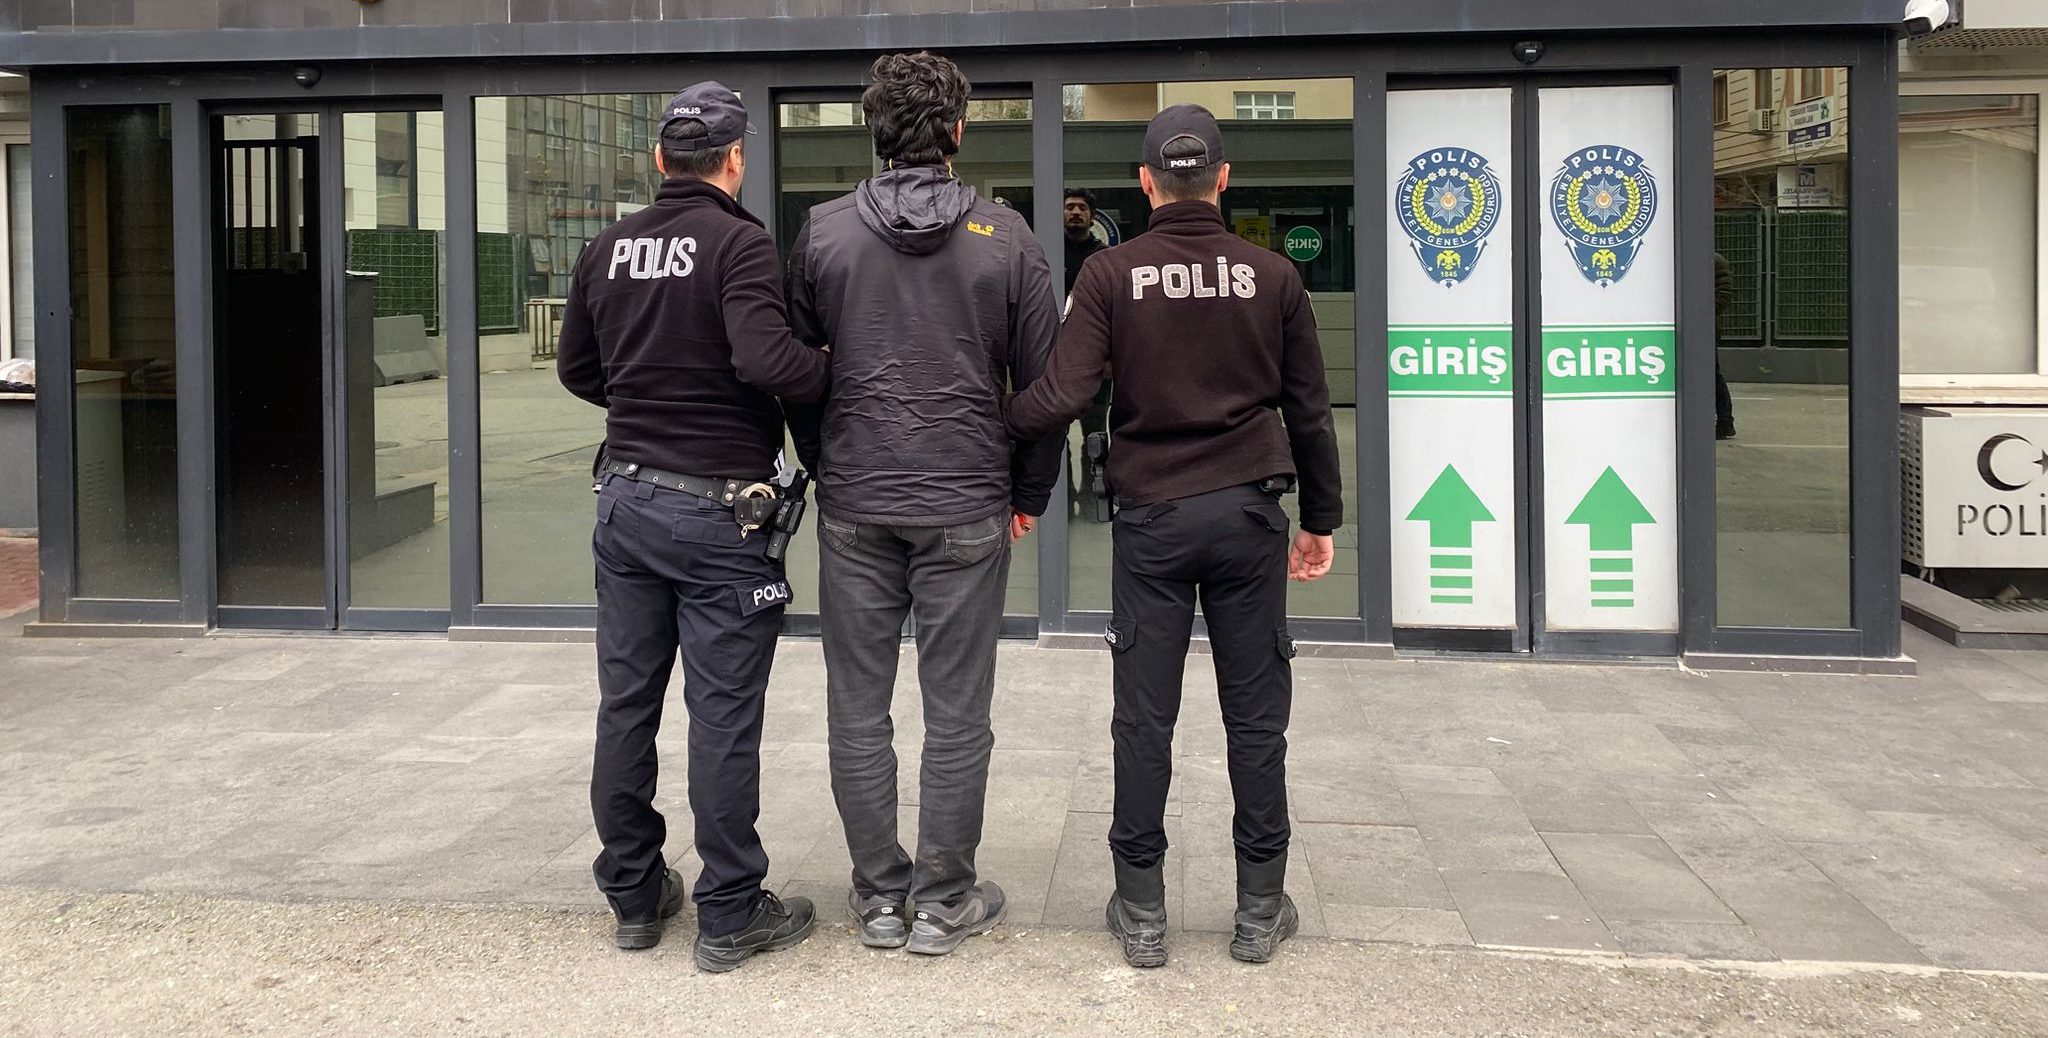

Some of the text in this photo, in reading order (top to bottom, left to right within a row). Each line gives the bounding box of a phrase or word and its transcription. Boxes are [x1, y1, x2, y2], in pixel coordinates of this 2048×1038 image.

[1416, 150, 1480, 171] POLİS
[1571, 149, 1635, 169] POLİS
[1427, 236, 1468, 246] GENEL
[1582, 234, 1623, 245] GENEL
[1131, 256, 1256, 300] POLİS
[1596, 270, 1613, 278] 1845
[1390, 338, 1508, 384] GİRİŞ
[1547, 338, 1666, 384] GİRİŞ
[1957, 492, 2047, 536] POLİ
